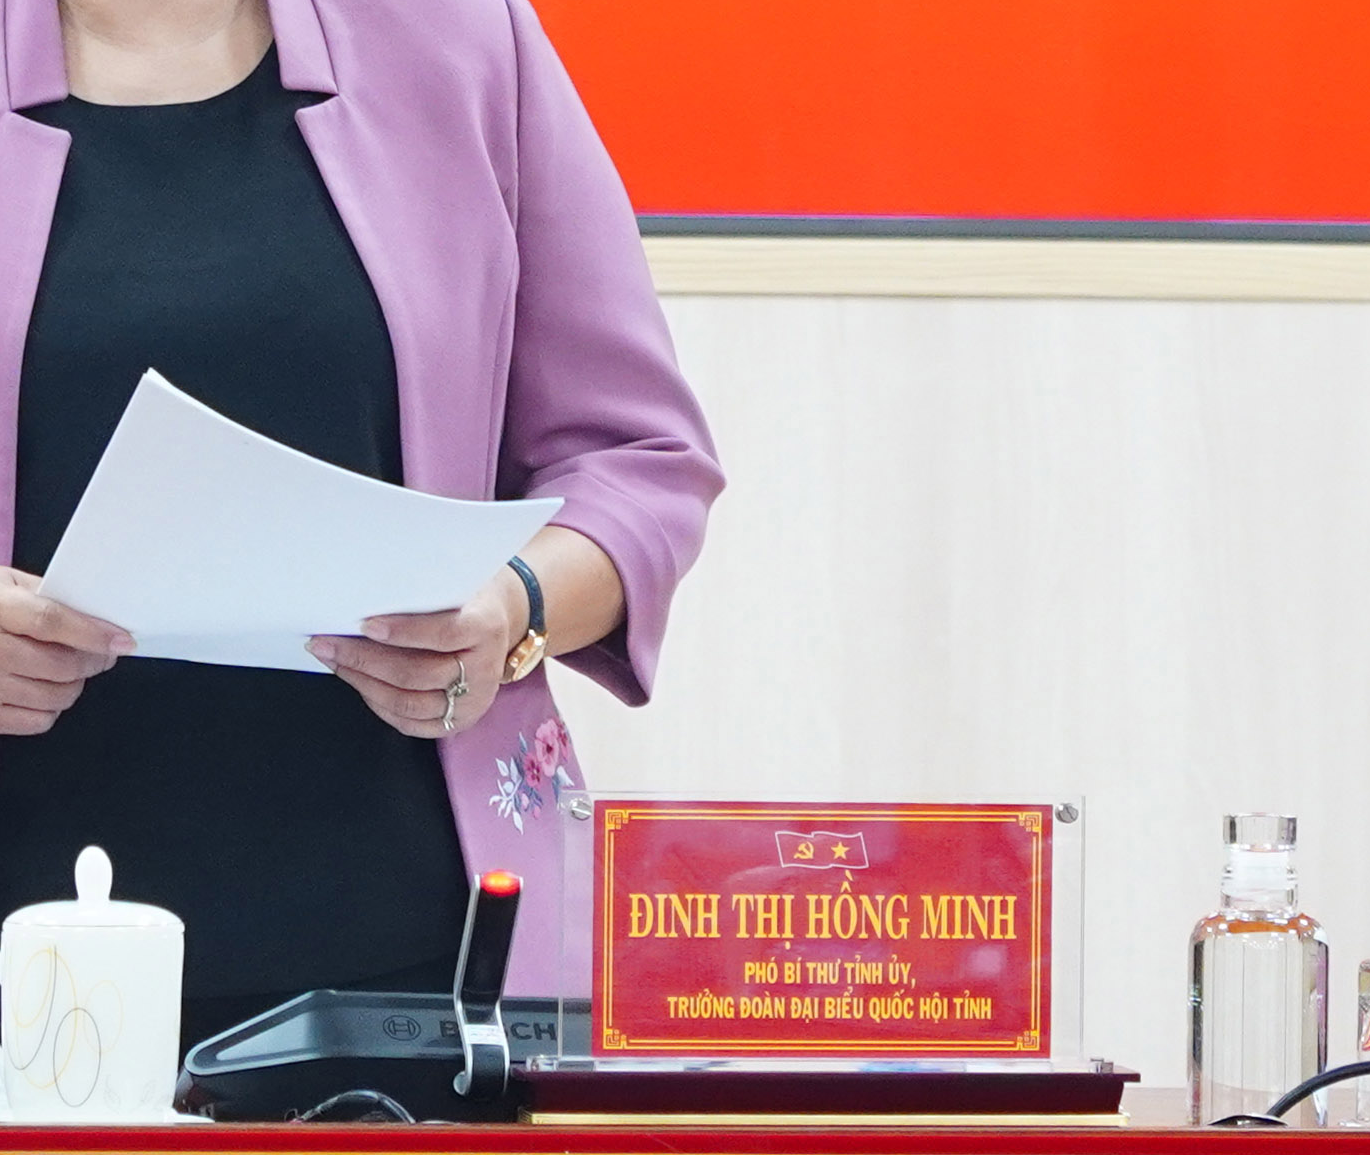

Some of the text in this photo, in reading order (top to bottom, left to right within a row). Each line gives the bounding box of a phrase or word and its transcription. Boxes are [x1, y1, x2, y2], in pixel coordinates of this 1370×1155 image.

[628, 870, 1017, 950] ĐINH THỊ HỒNG MINH
[744, 954, 916, 989] PHÓ BÍ THƯ TỈNH ỦY,
[667, 986, 992, 1024] TRƯỞNG ĐOÀN ĐẠI BIỂU QUỐC HỘI TỈNH
[440, 1020, 557, 1042] BCH
